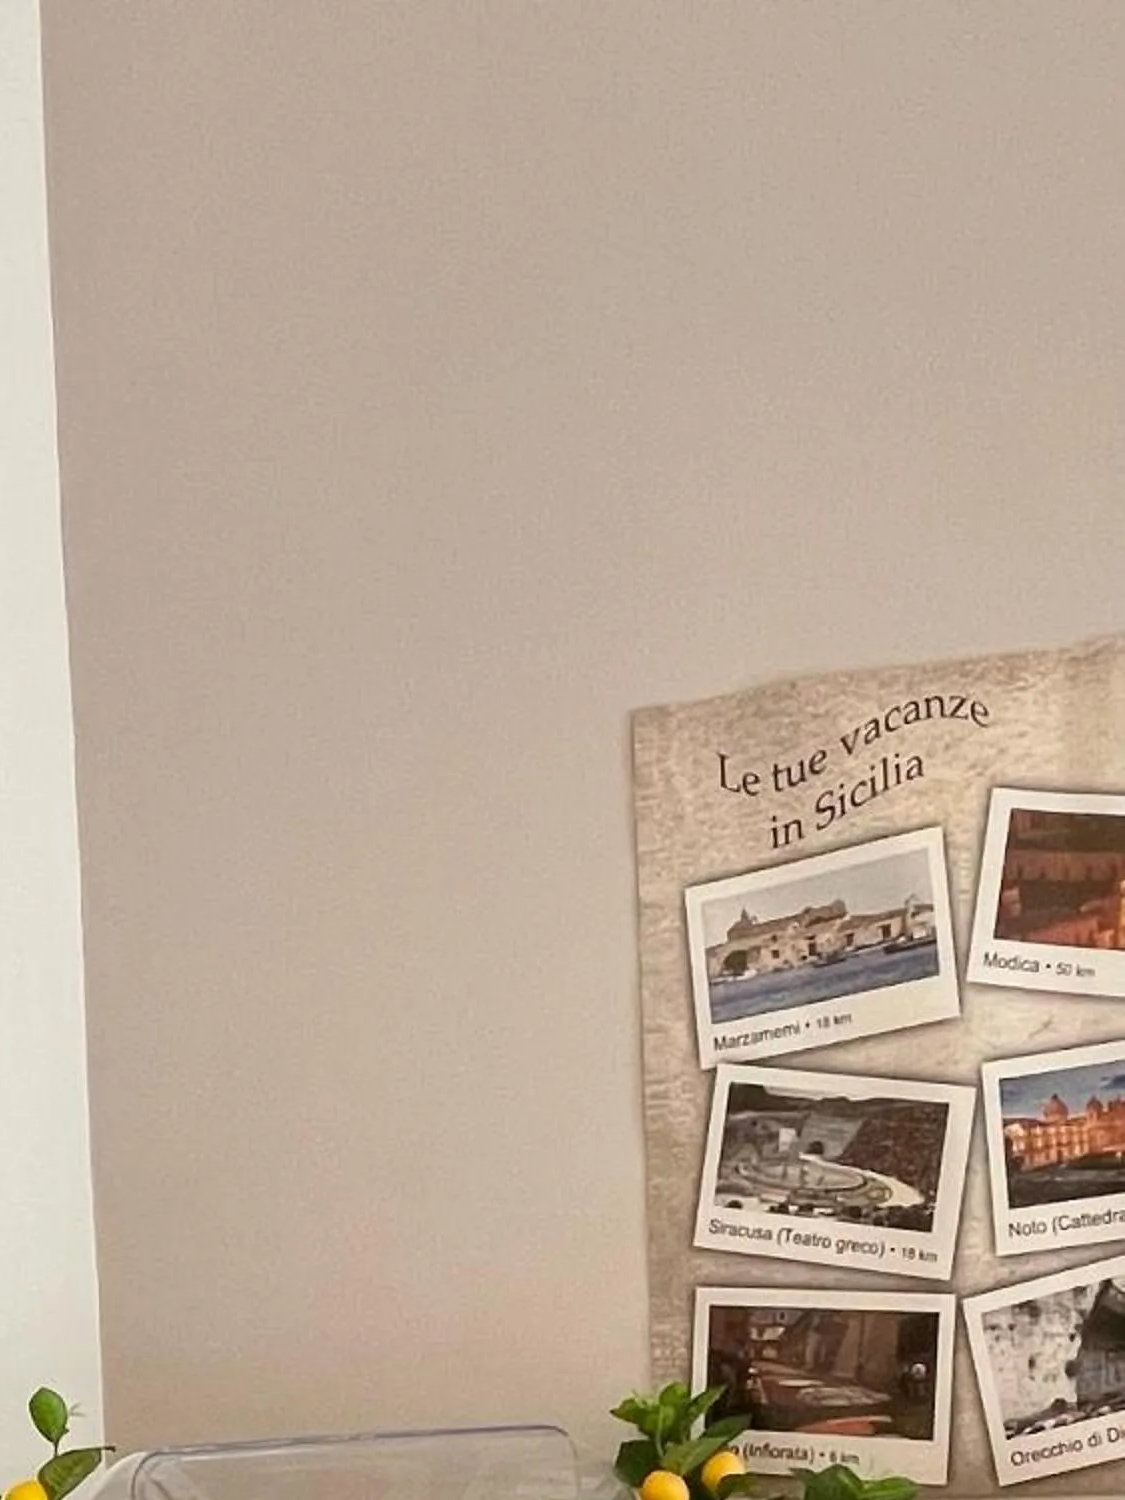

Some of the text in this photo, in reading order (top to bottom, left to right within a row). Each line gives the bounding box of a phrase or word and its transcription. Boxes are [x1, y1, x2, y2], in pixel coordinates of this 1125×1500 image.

[717, 694, 990, 796] Le tue vacanze
[770, 752, 924, 848] in Sicilia
[983, 951, 1039, 973] Modica
[714, 1020, 800, 1051] Marzamemi
[708, 1218, 773, 1241] Siracusa
[777, 1226, 831, 1249] (Teatro
[835, 1238, 885, 1258] greco)
[1008, 1221, 1047, 1237] Noto
[1011, 1440, 1084, 1466] Orecchio
